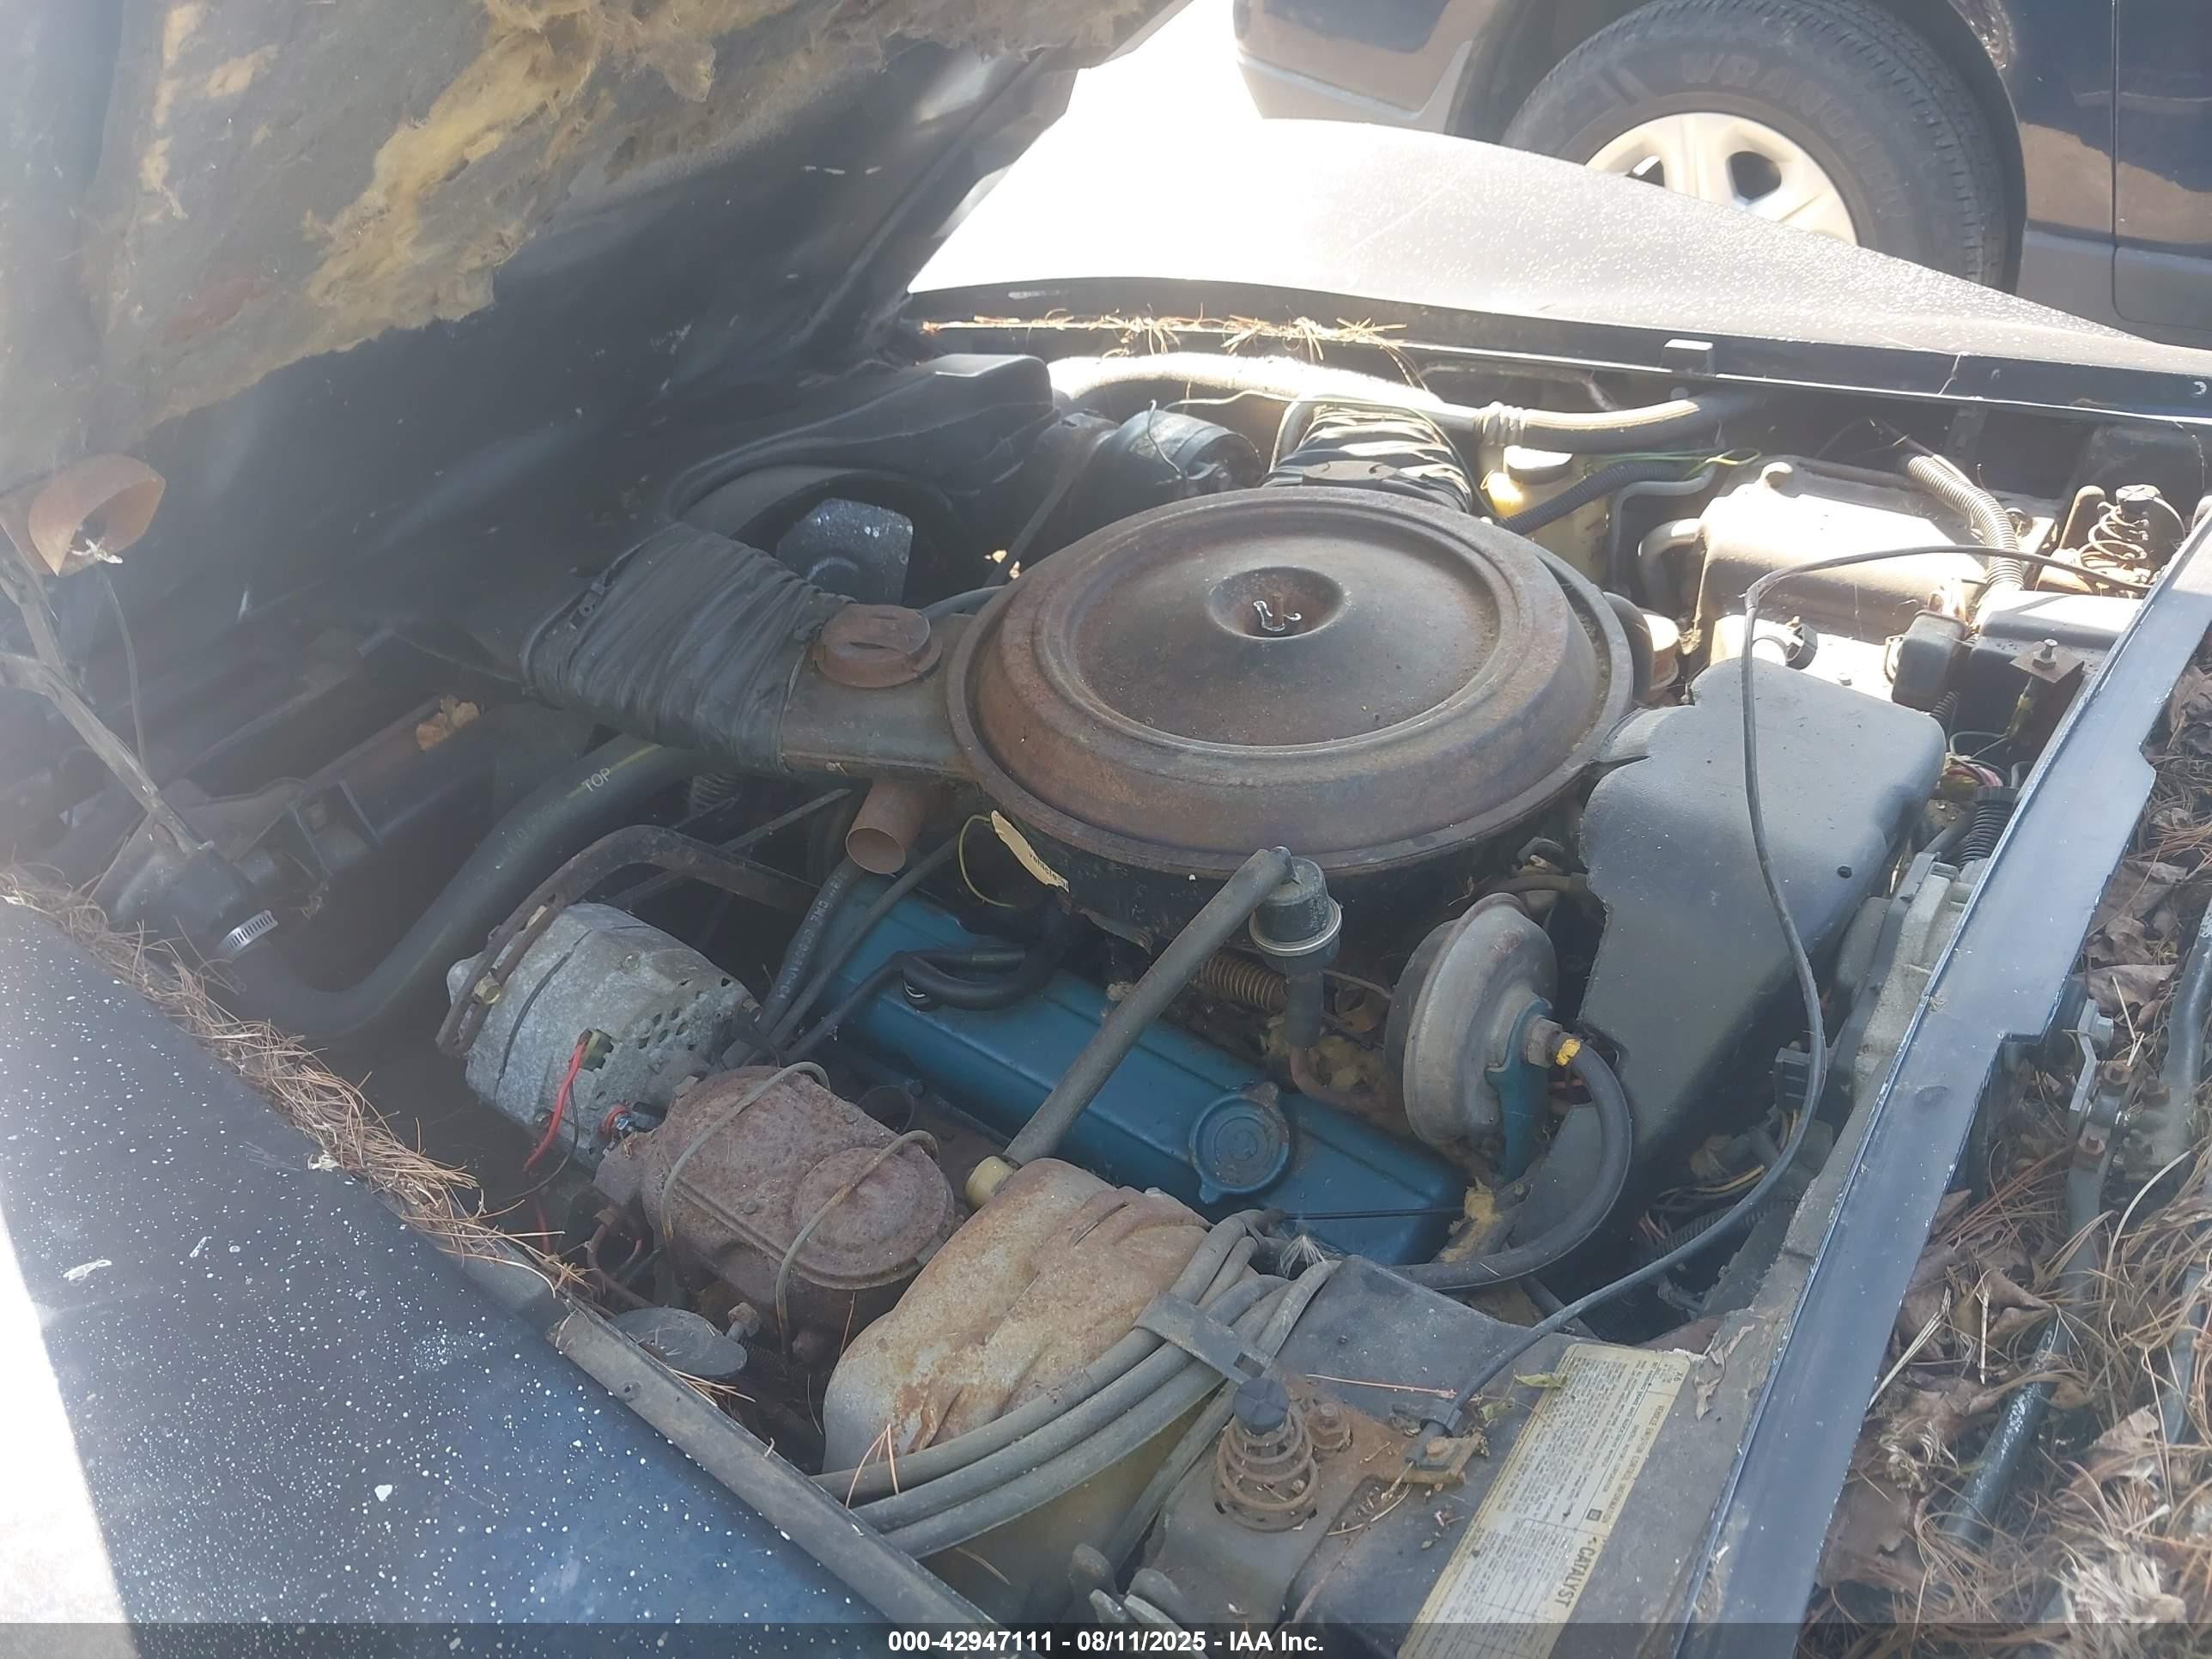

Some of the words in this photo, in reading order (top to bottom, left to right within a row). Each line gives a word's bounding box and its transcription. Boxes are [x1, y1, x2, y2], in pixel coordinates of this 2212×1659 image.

[1677, 52, 1909, 221] WRANGLER
[581, 767, 611, 793] TOP
[1029, 851, 1057, 881] vehicle
[1555, 1547, 1596, 1607] CATALYST
